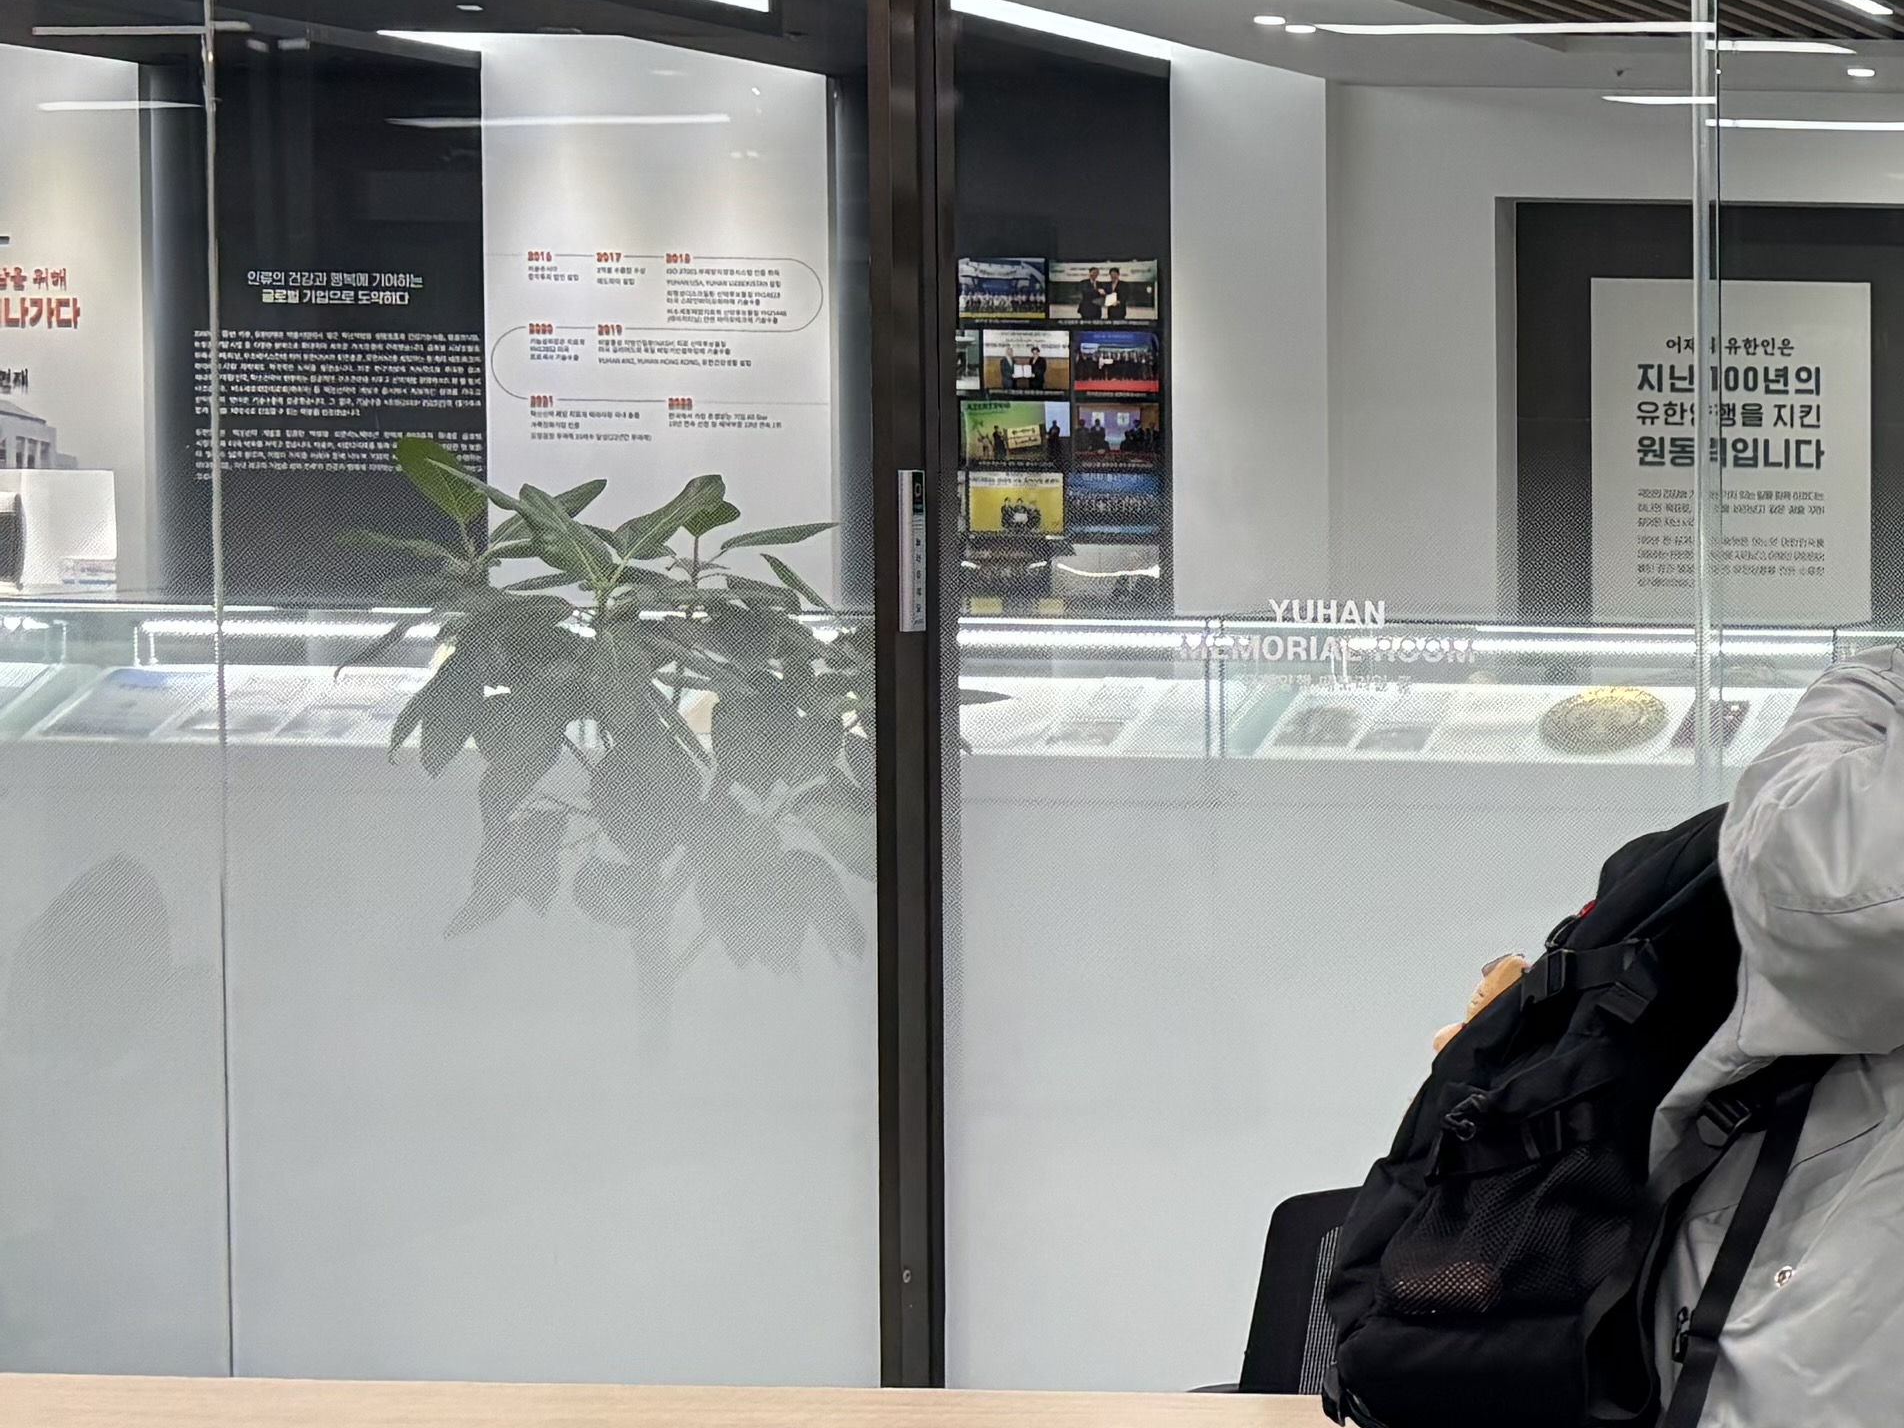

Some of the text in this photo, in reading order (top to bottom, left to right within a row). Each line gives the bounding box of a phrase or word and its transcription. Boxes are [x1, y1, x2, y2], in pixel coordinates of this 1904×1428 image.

[596, 252, 621, 262] 2017
[33, 268, 67, 291] 위해
[247, 270, 285, 285] 인류의
[289, 271, 326, 286] 건강과
[302, 289, 355, 304] 기업으로
[358, 290, 409, 305] 도약하다
[0, 297, 81, 330] 나가다
[1724, 337, 1795, 357] 유한인은
[1636, 363, 1821, 396] 지난 100년의
[1773, 403, 1821, 429] 지킨
[1269, 599, 1387, 627] YUHAN
